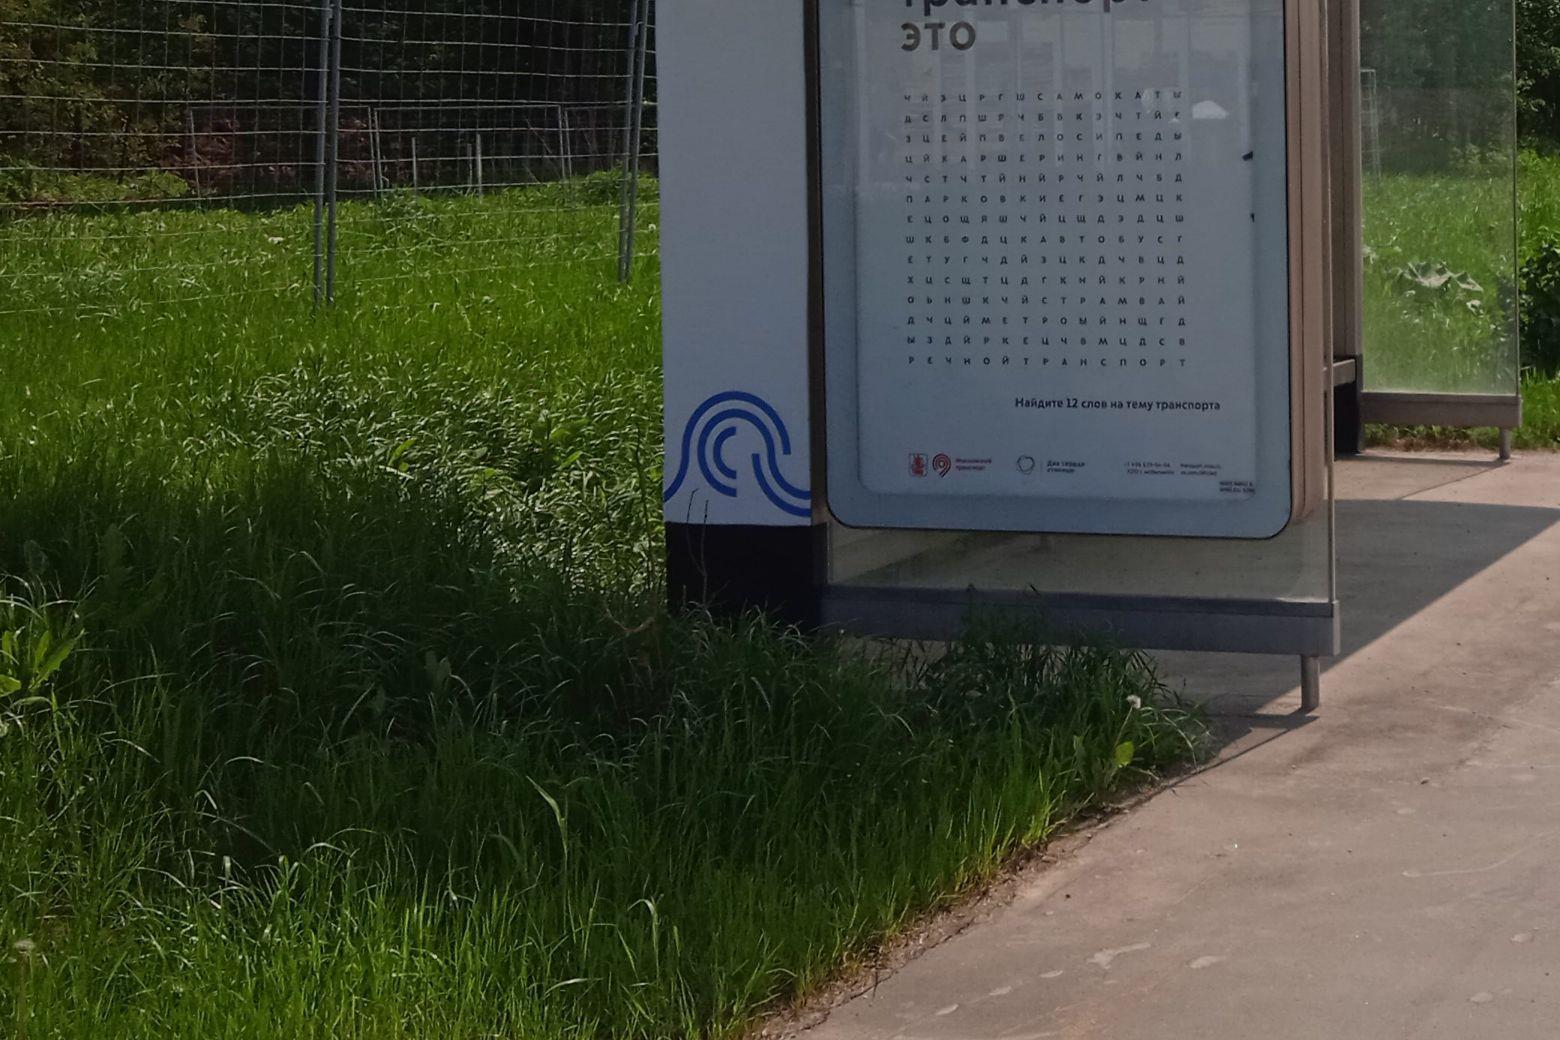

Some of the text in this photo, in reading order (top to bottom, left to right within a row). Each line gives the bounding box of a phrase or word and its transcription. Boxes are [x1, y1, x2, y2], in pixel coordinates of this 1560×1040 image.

[900, 21, 976, 51] это
[1015, 397, 1220, 412] Найдите 12 слов на тему транспорта
